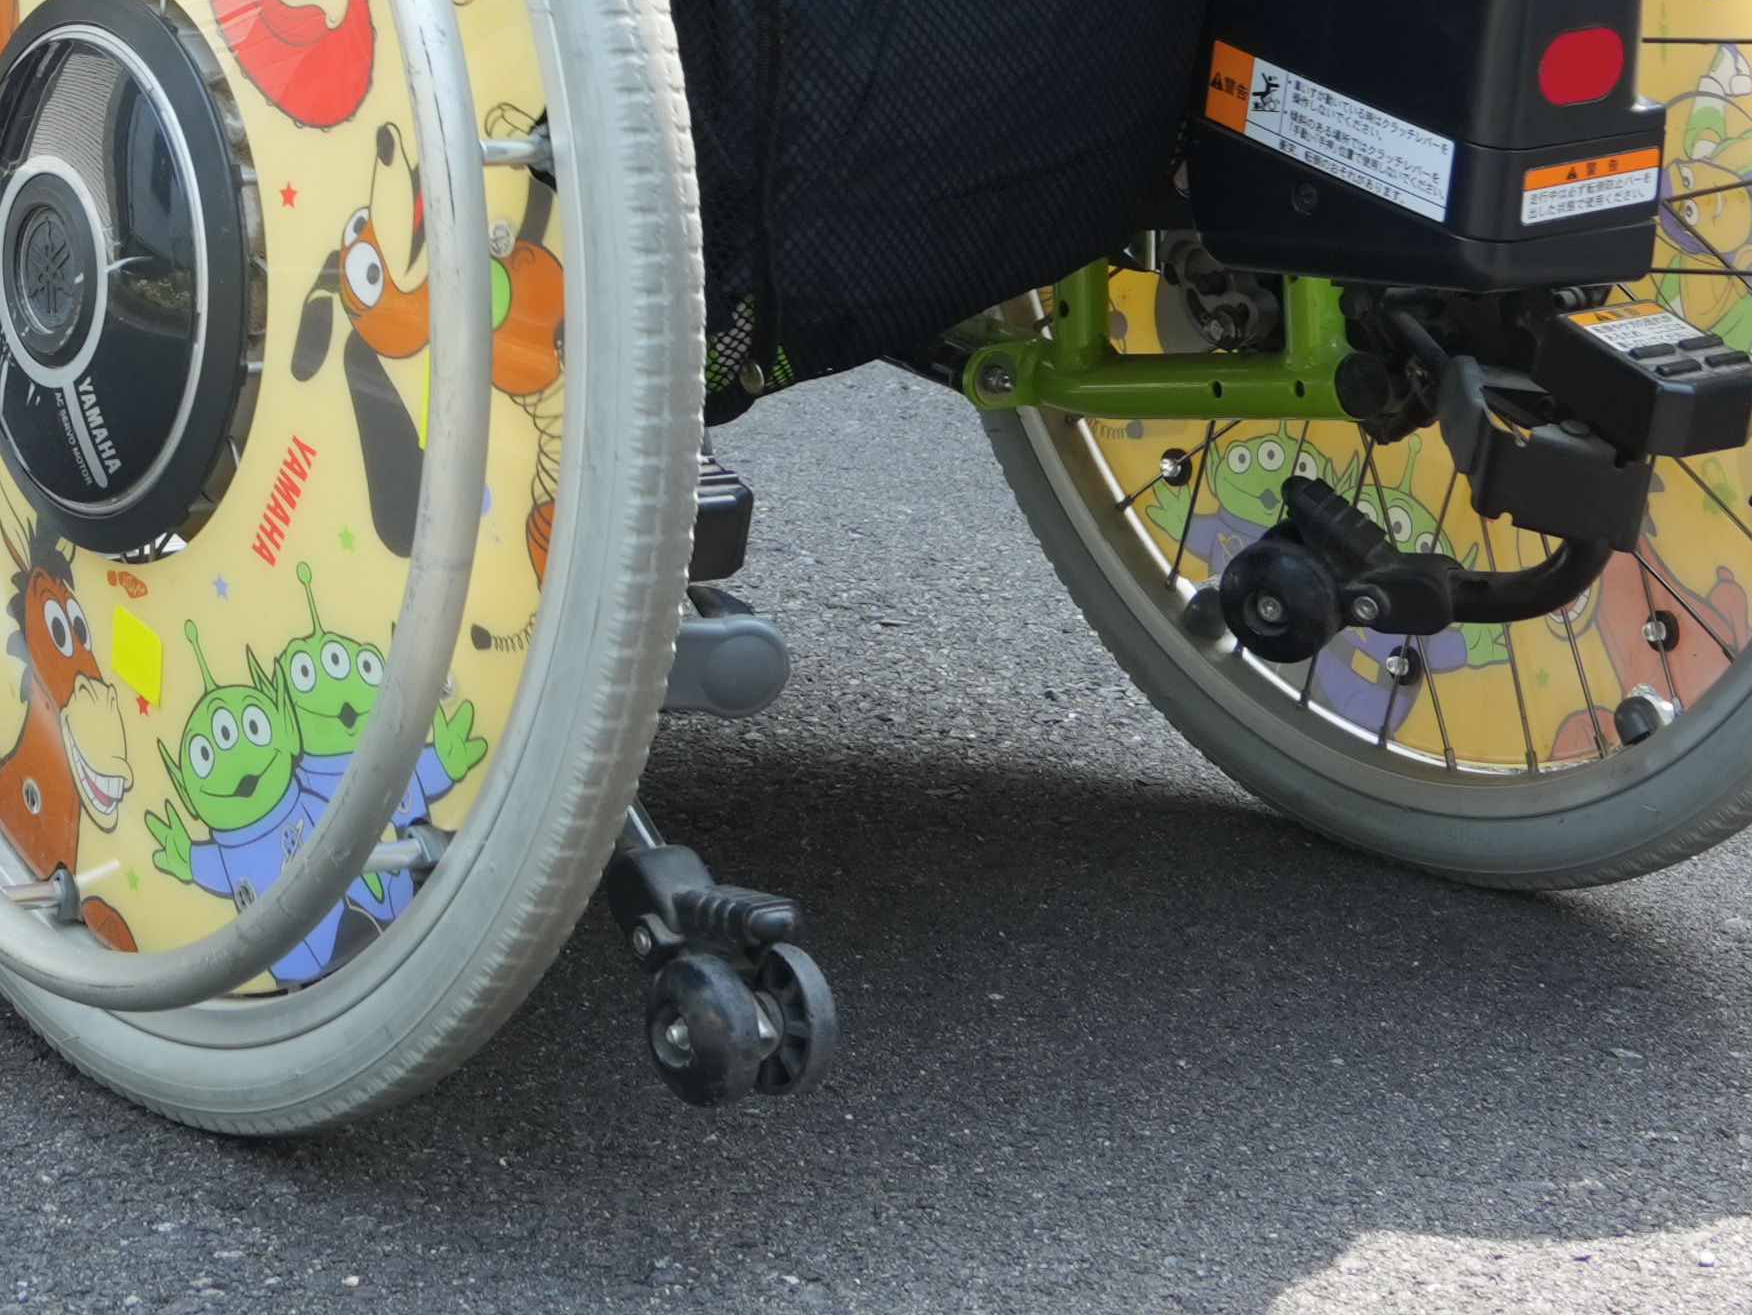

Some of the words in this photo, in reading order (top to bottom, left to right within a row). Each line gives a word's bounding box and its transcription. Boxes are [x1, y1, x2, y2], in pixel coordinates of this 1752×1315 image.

[1223, 76, 1248, 101] 警告
[54, 392, 65, 407] AC
[59, 409, 77, 445] SERVO
[78, 376, 123, 475] YAMAHA
[72, 446, 94, 486] MOTOR
[252, 435, 318, 567] YAMAHA
